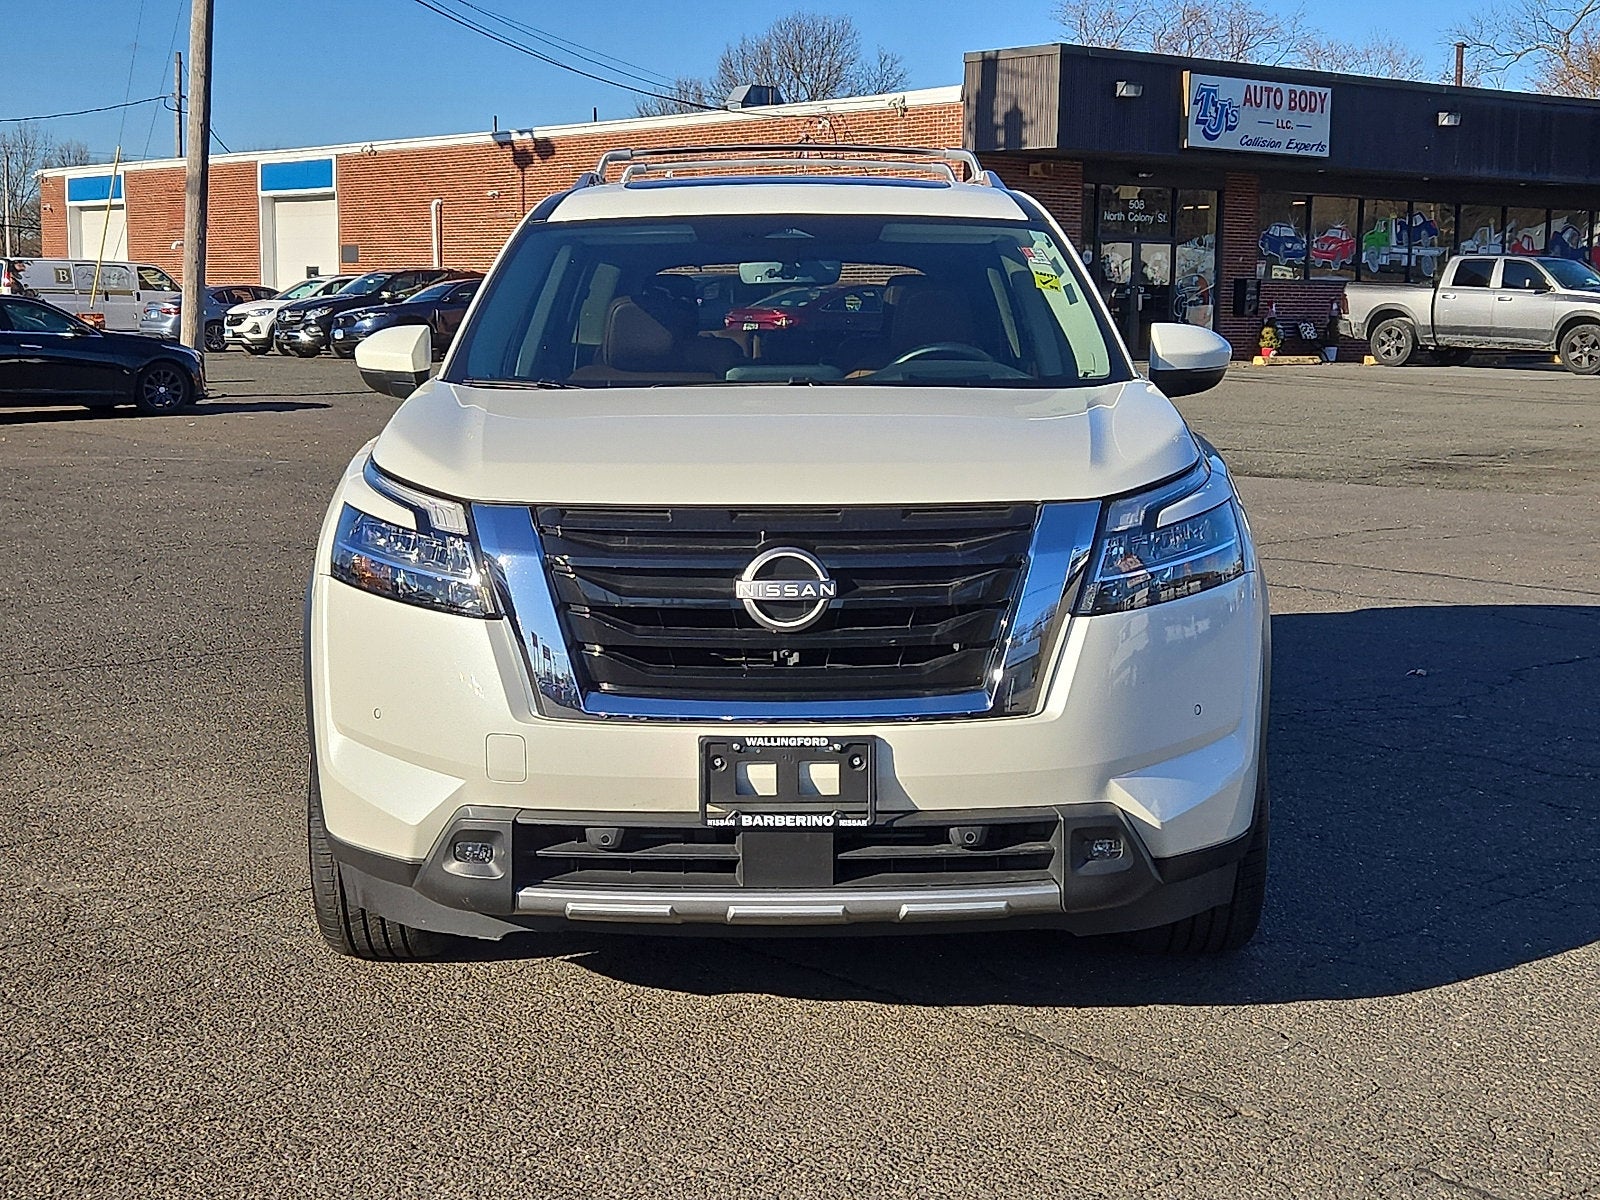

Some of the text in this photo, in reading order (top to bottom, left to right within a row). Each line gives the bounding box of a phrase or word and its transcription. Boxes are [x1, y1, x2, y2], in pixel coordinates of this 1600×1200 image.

[1243, 84, 1328, 114] AUTO BODY
[1193, 83, 1240, 141] TJ's
[1276, 119, 1294, 130] LLC.
[1239, 134, 1327, 153] Collision Experts
[1103, 210, 1168, 224] North Colony St.
[58, 269, 68, 282] B
[738, 583, 835, 597] NISSAN
[745, 737, 829, 747] WALLINGFORD
[741, 814, 835, 827] BARBERINO
